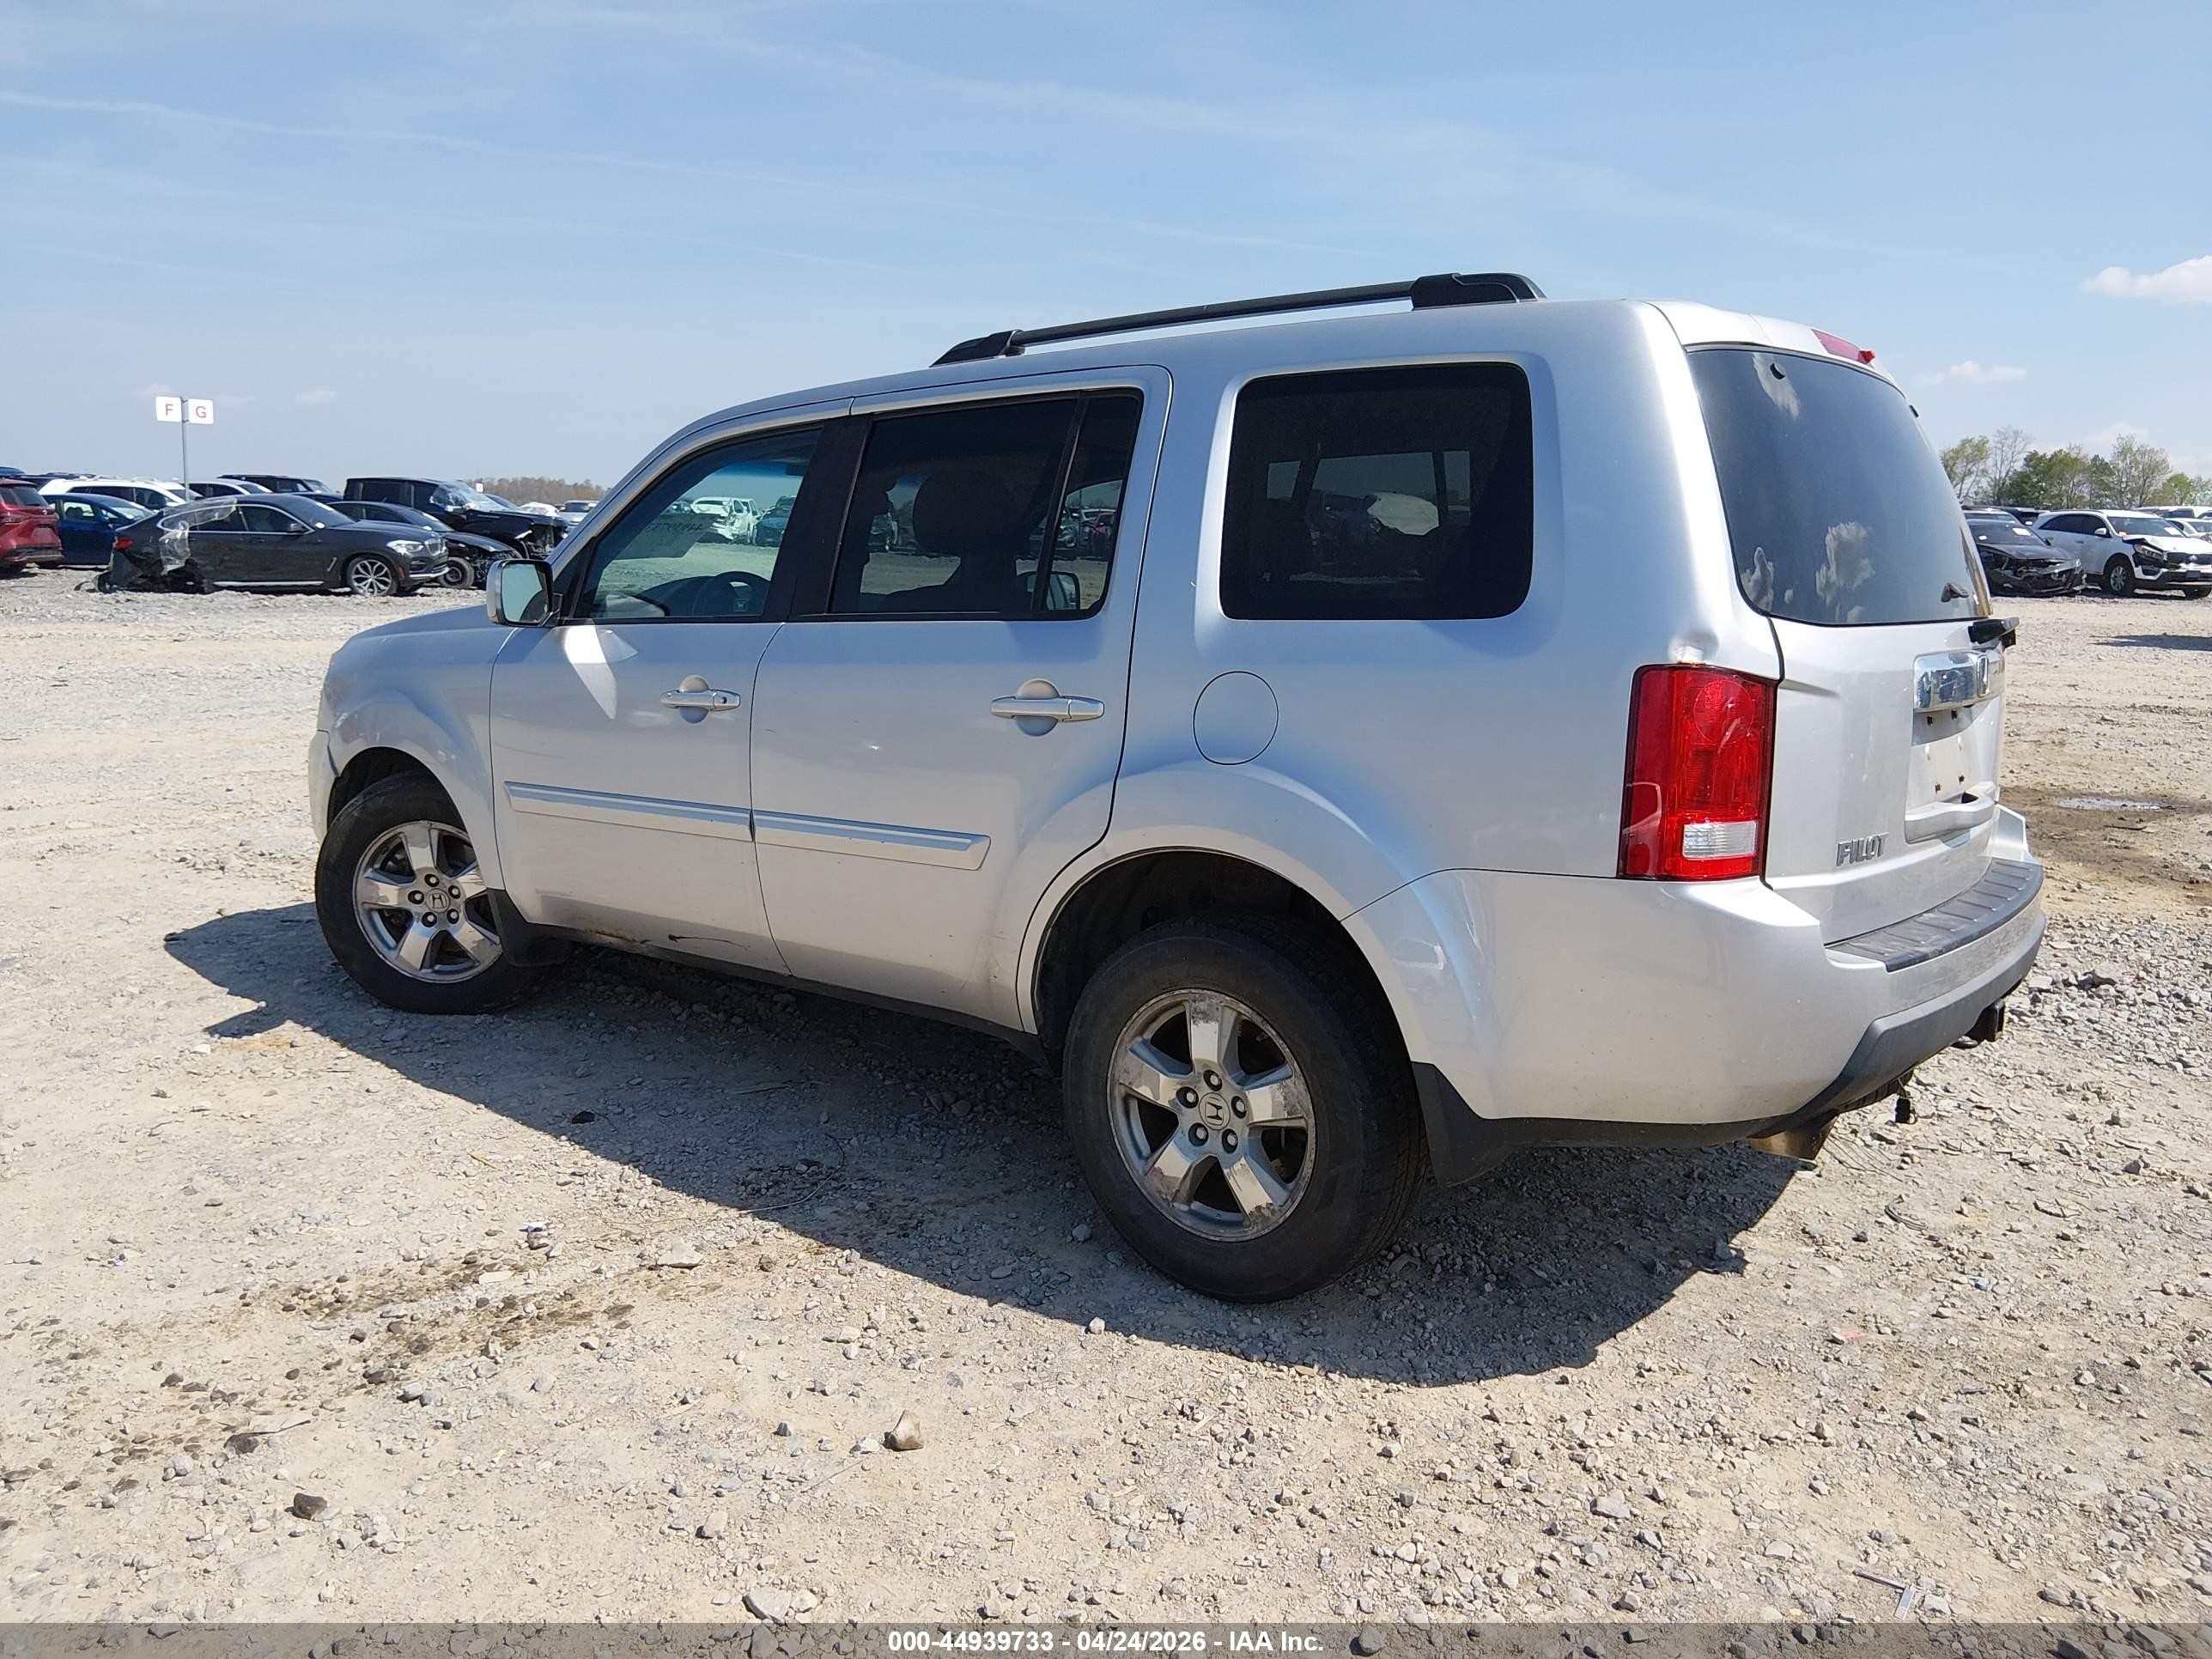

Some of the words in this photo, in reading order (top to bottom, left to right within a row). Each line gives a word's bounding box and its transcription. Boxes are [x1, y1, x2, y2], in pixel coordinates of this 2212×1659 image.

[165, 404, 174, 416] F
[195, 405, 207, 418] G
[1836, 832, 1889, 867] PILOT
